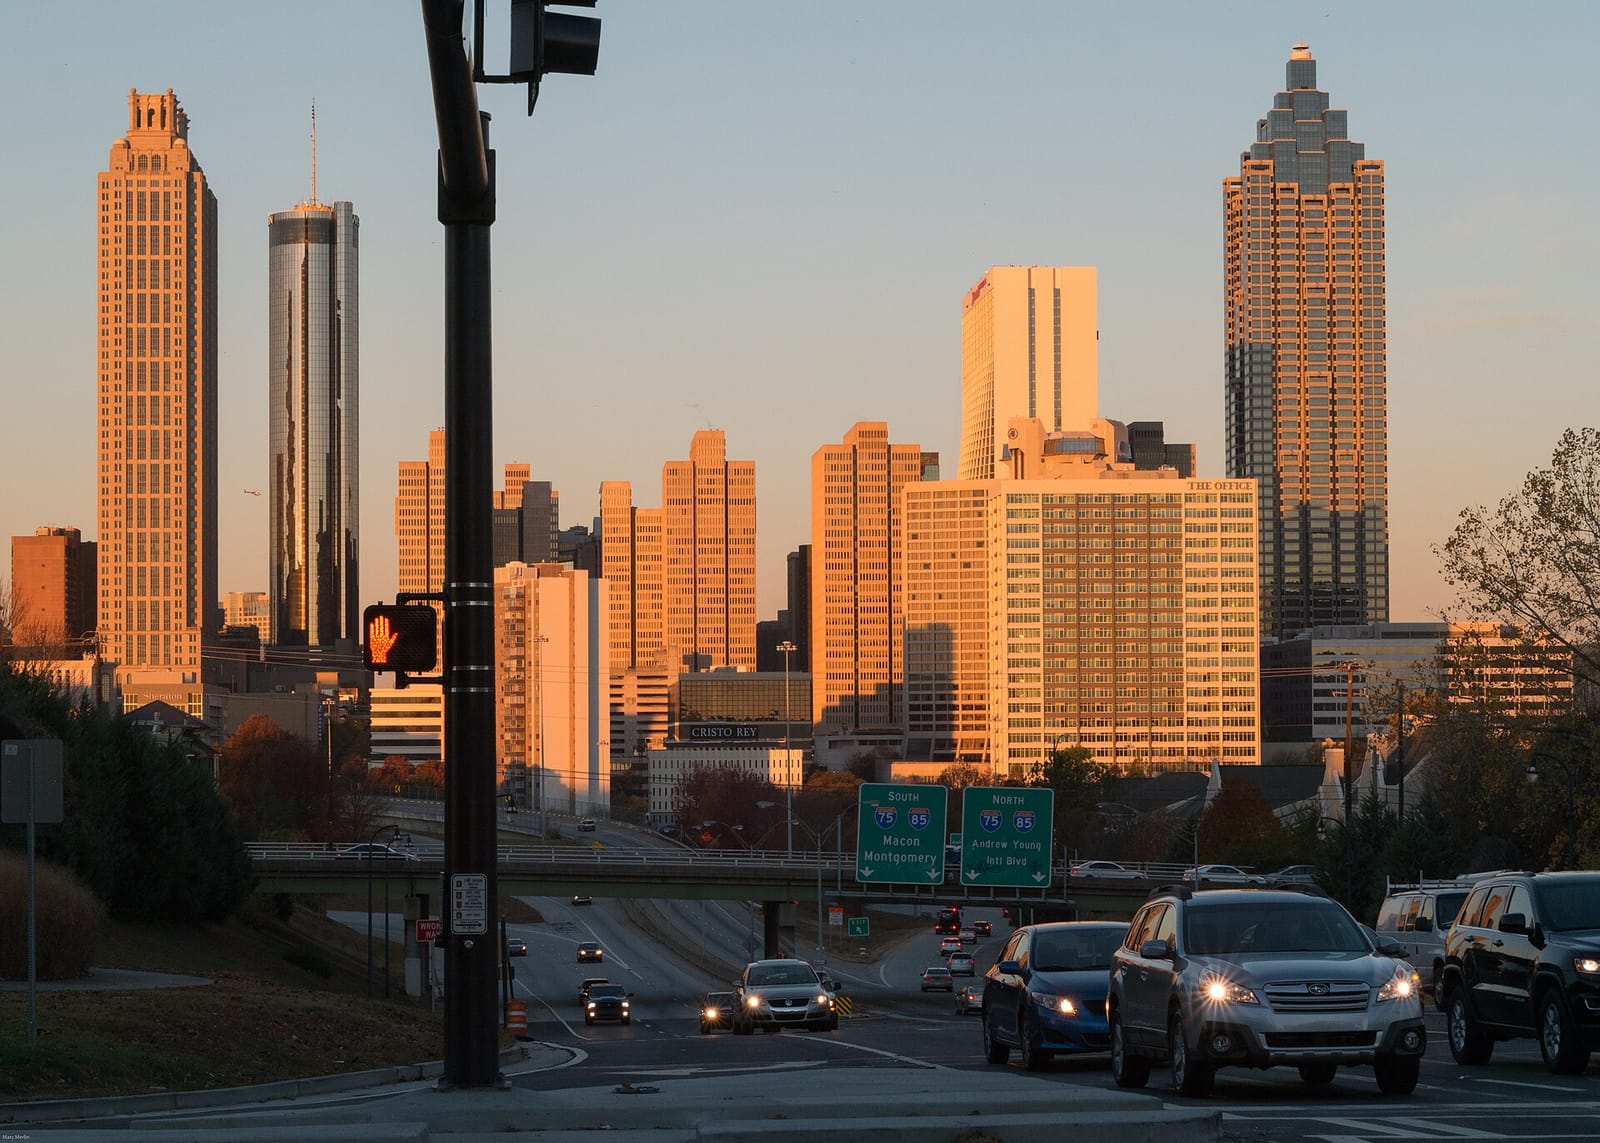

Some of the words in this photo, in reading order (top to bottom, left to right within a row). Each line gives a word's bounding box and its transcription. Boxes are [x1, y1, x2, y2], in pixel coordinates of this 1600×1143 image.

[1187, 481, 1212, 490] THE
[1214, 481, 1252, 490] OFFICE
[143, 692, 183, 700] Sheraton
[691, 727, 732, 737] CRISTO
[736, 727, 757, 737] REY
[888, 791, 920, 802] SOUTH
[992, 795, 1024, 805] NORTH
[878, 812, 894, 824] 75
[911, 814, 927, 825] 85
[983, 815, 999, 826] 75
[1016, 817, 1032, 828] 85
[883, 835, 920, 846] Macon
[972, 839, 1008, 849] Andrew
[1012, 840, 1041, 851] Young
[864, 851, 937, 866] Montgomery
[1006, 856, 1027, 866] Blvd
[420, 922, 441, 930] WRON
